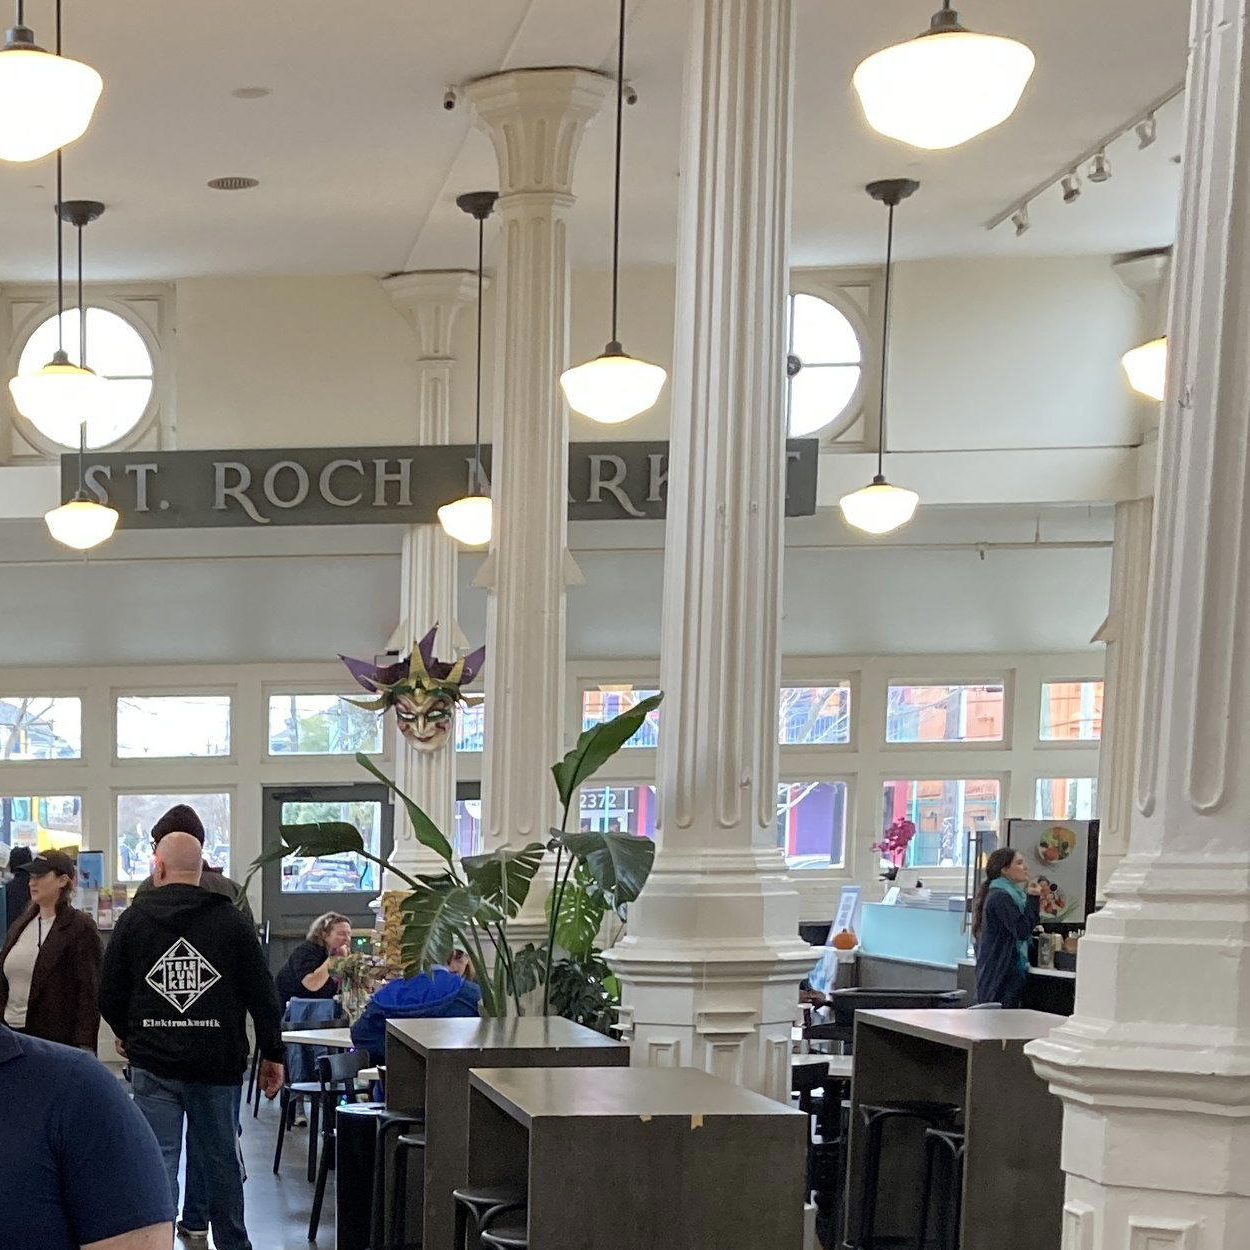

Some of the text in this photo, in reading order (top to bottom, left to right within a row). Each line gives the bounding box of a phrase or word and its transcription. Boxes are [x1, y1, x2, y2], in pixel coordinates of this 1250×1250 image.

[84, 463, 170, 511] ST.
[212, 458, 414, 523] ROCH
[580, 794, 617, 808] 2372
[166, 961, 196, 970] TELE
[168, 980, 196, 989] KEN
